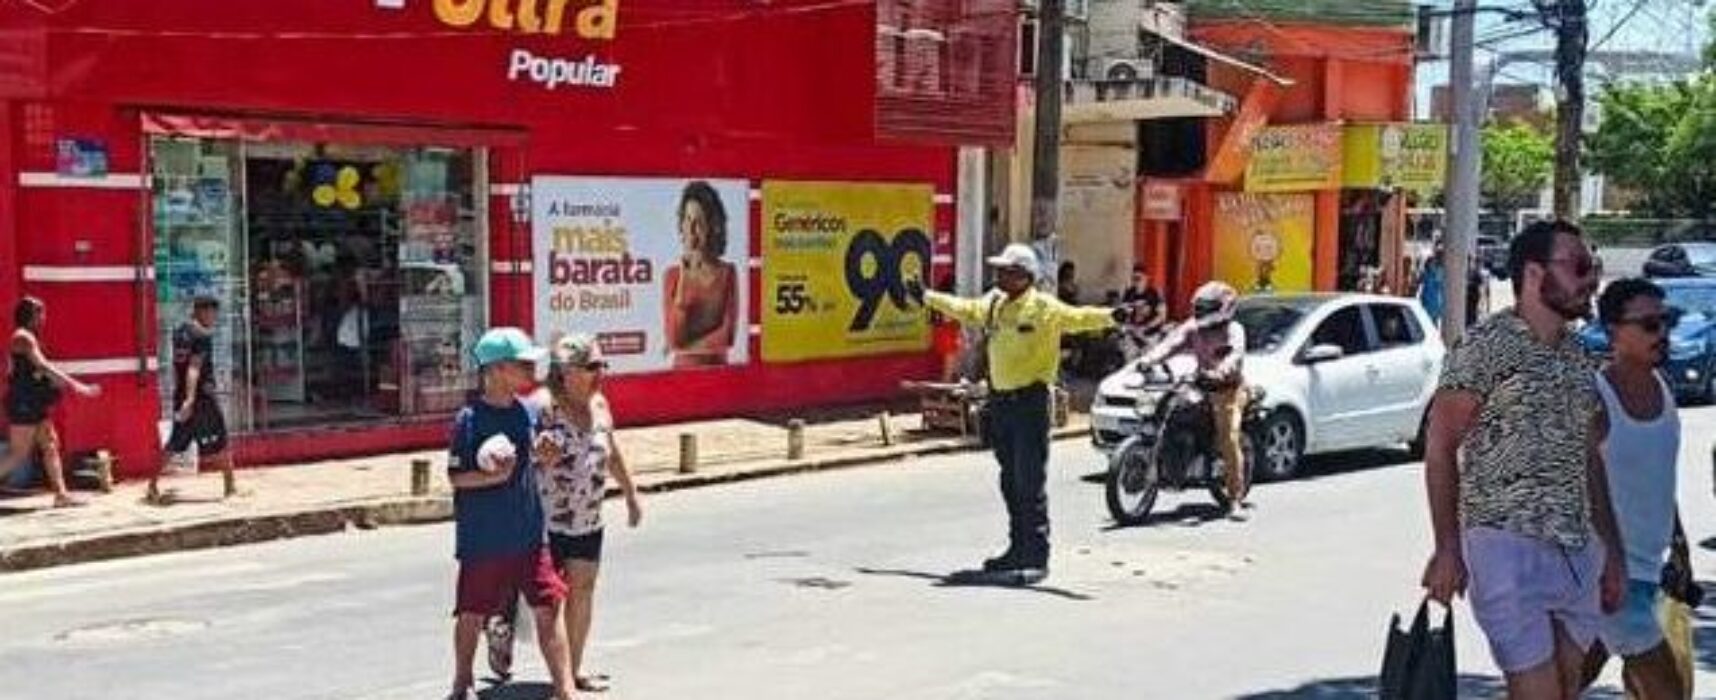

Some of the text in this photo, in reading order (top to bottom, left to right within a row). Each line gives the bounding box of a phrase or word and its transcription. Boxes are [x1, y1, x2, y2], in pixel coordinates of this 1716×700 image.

[507, 50, 621, 89] Popular
[548, 200, 559, 217] A
[552, 219, 626, 252] mais
[549, 251, 652, 284] barata
[550, 290, 631, 311] do Brasil
